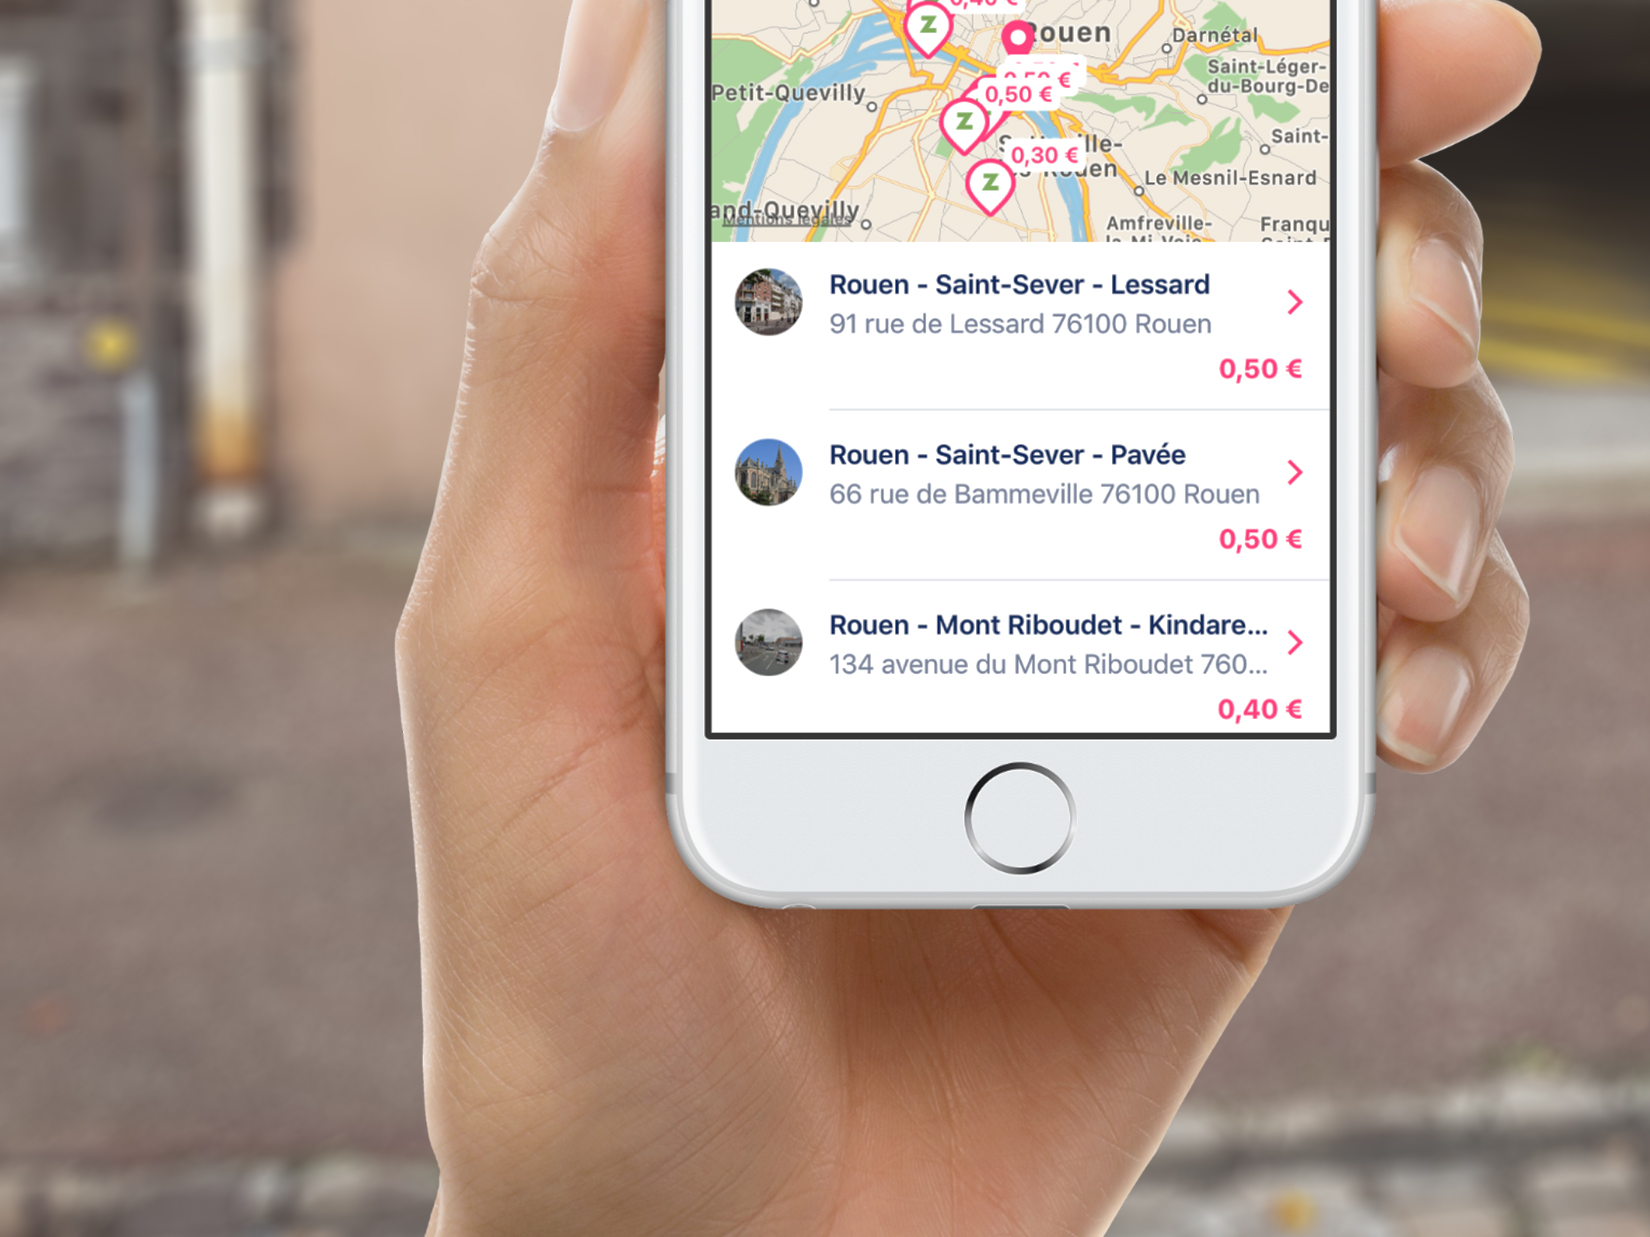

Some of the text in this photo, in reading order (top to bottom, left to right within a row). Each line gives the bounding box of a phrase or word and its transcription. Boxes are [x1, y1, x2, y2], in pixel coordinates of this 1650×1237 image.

[1173, 26, 1258, 43] Darnétal
[1208, 58, 1326, 78] Saint-Léger-
[712, 83, 866, 105] Petit-Quevilly
[985, 86, 1052, 106] 0,50 €
[1208, 78, 1329, 97] du-Bourg-De
[1271, 128, 1328, 143] Saint-
[1011, 146, 1078, 168] 0,30 €
[1145, 170, 1317, 185] Le Mesnil-Esnard
[1106, 215, 1212, 230] Amfreville-
[831, 274, 909, 294] Rouen
[936, 273, 1085, 295] Saint-Sever
[1112, 273, 1209, 295] Lessard
[831, 313, 1211, 334] 91 rue de Lessard 76100 Rouen
[1220, 358, 1302, 384] 0,50 €
[831, 444, 909, 465] Rouen
[936, 443, 1085, 465] Saint-Sever
[1112, 442, 1186, 465] Pavée
[831, 483, 1259, 504] 66 rue de Bammeville 76100 Rouen
[1219, 529, 1302, 554] 0,50 €
[831, 615, 909, 635] Rouen
[937, 615, 1000, 635] Mont
[1009, 614, 1122, 635] Riboudet
[1150, 614, 1267, 635] Kindare...
[831, 653, 1267, 674] 134 avenue du Mont Riboudet 760...
[1218, 699, 1302, 724] 0,40 €
